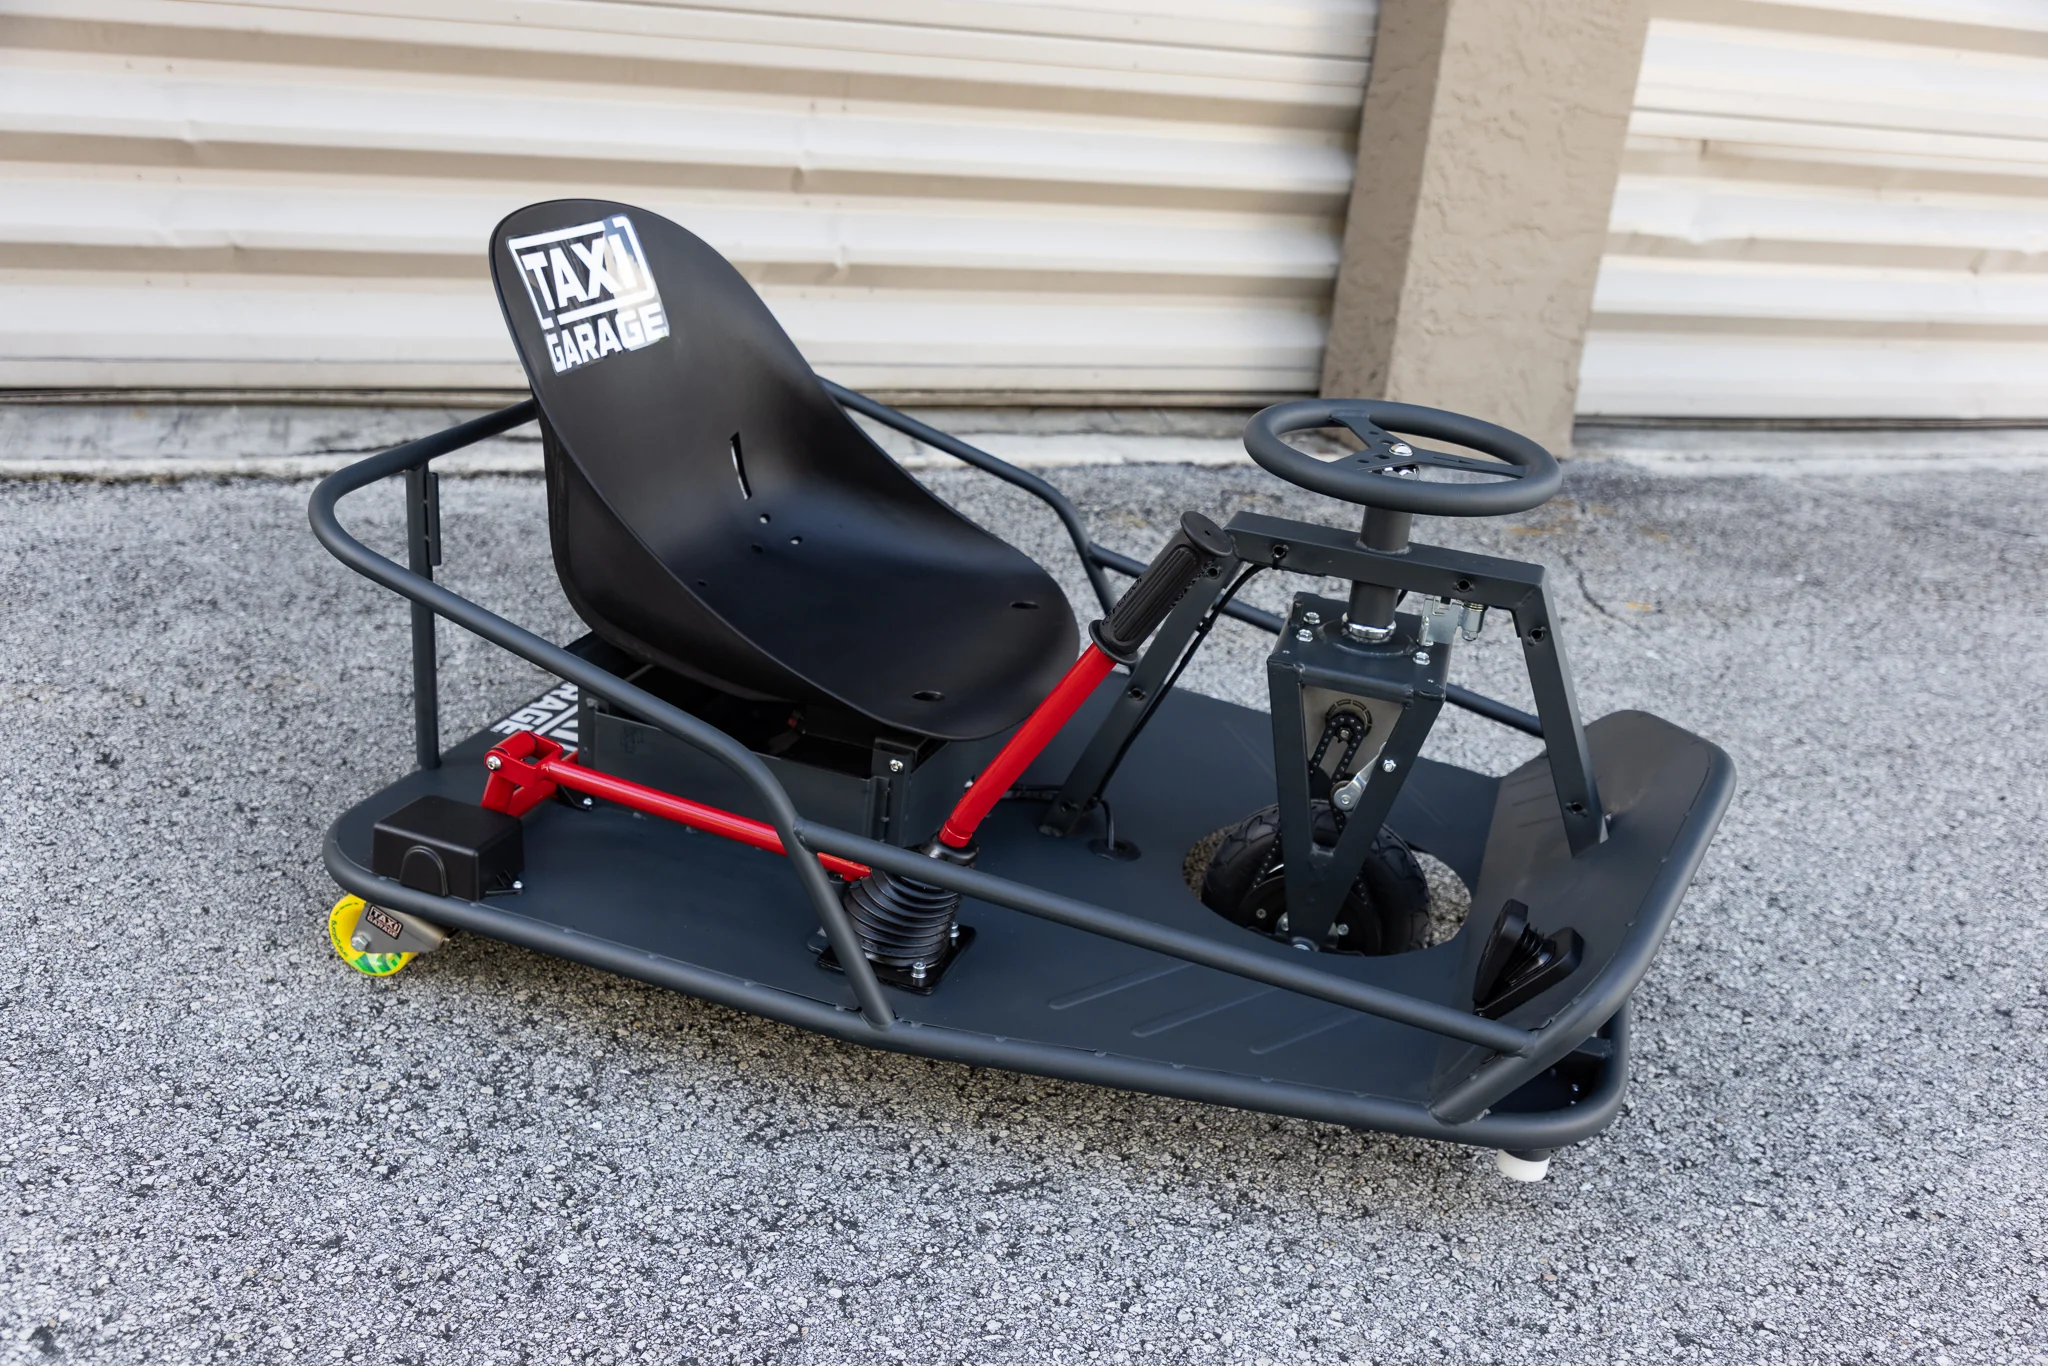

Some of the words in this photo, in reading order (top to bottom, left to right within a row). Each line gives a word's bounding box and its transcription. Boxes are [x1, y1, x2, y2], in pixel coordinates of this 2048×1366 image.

[521, 234, 637, 311] TAXI
[545, 302, 668, 373] GARAGE
[490, 682, 578, 734] RAGE
[367, 915, 398, 937] GARAGE
[372, 909, 399, 931] TAXI
